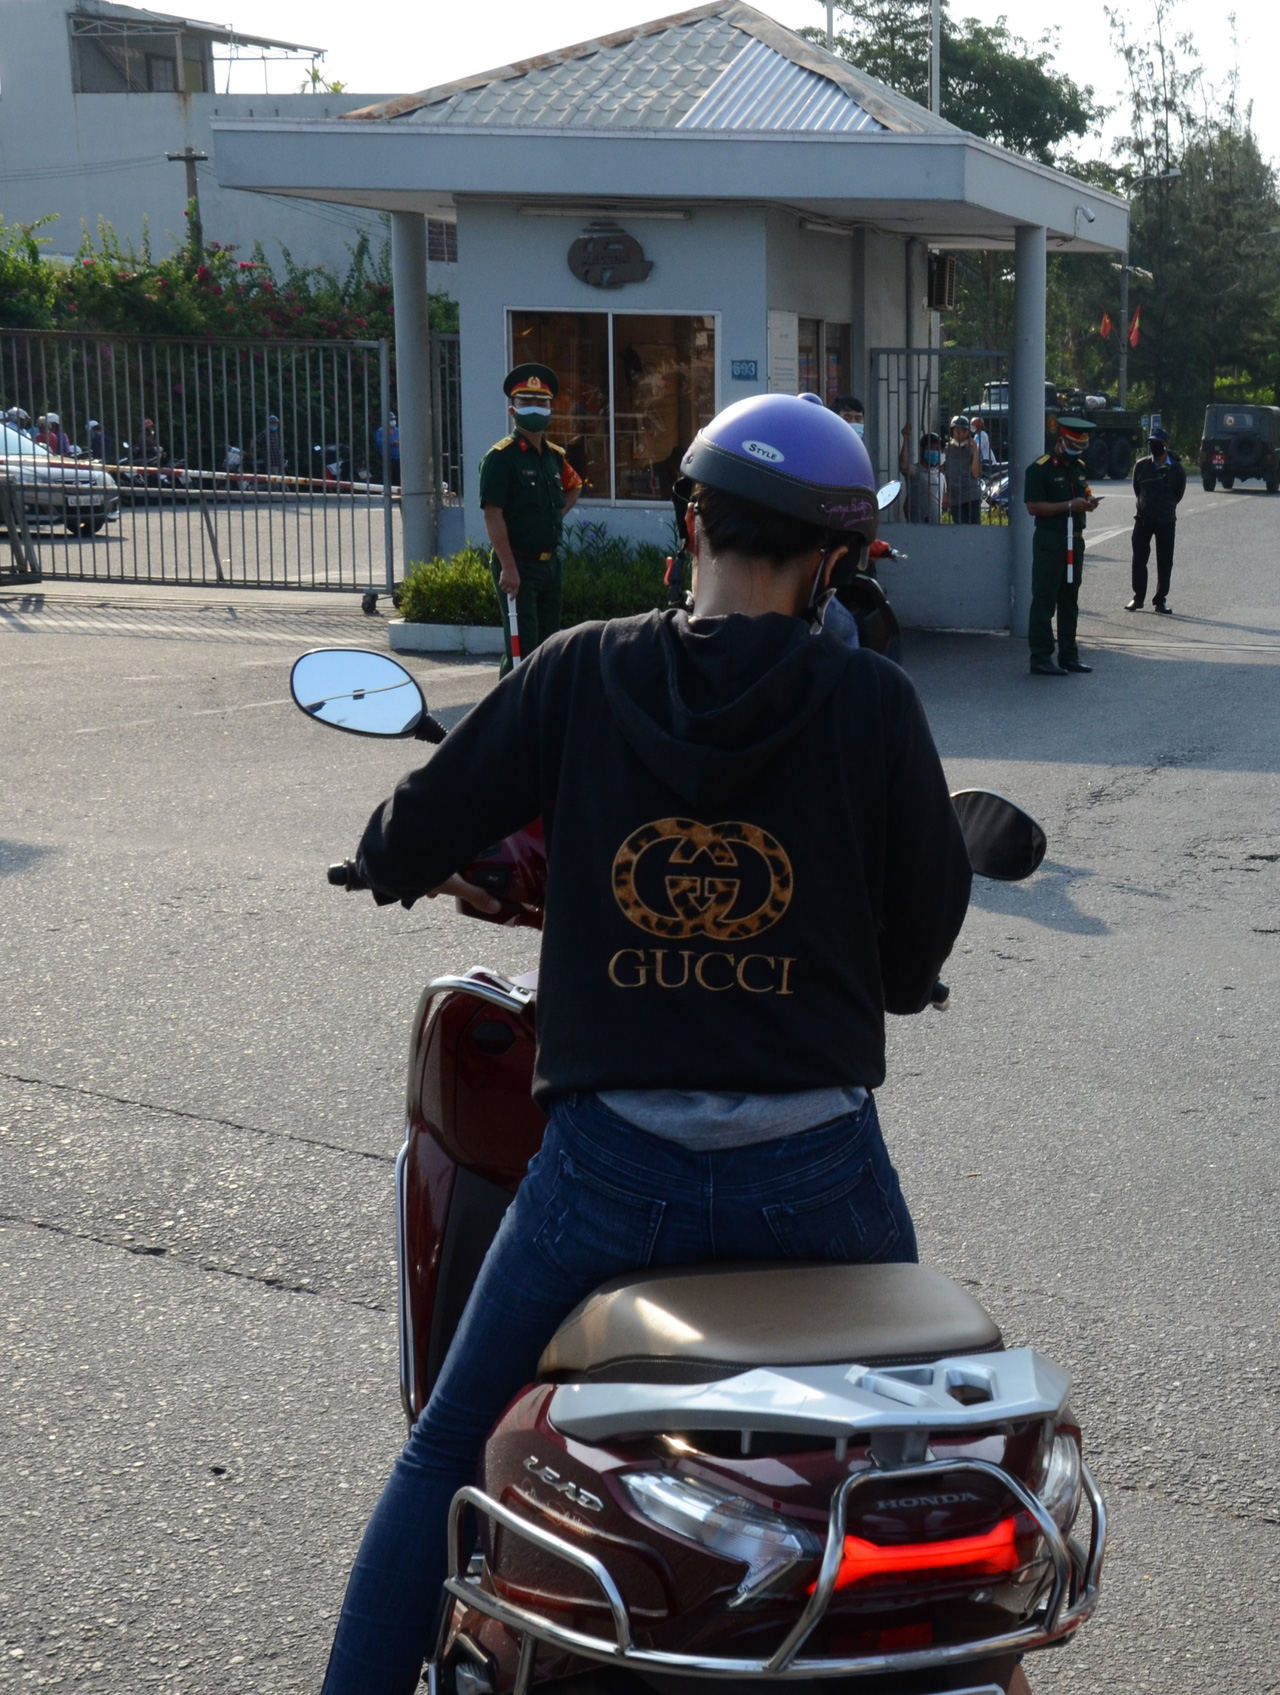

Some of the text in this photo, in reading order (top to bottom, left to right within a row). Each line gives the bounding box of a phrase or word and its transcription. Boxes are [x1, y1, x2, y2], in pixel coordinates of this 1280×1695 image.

[748, 442, 778, 461] STYLE
[607, 948, 798, 995] GUCCI
[876, 1492, 982, 1511] HONDA
